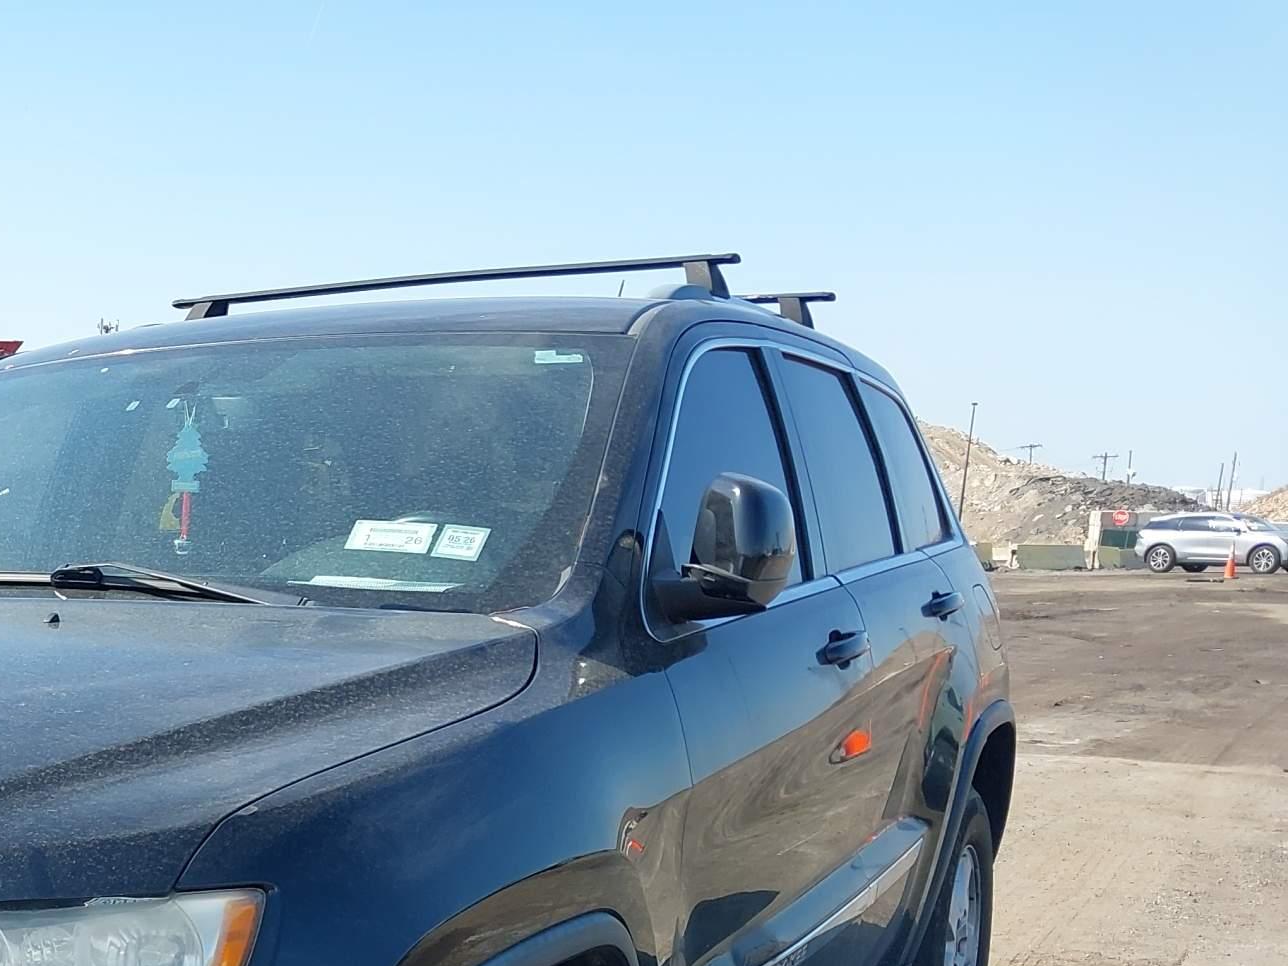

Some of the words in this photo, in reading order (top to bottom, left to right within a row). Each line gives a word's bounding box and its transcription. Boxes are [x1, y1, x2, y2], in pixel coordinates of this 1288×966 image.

[404, 536, 423, 545] 26
[447, 534, 462, 543] 05
[463, 536, 476, 544] 26
